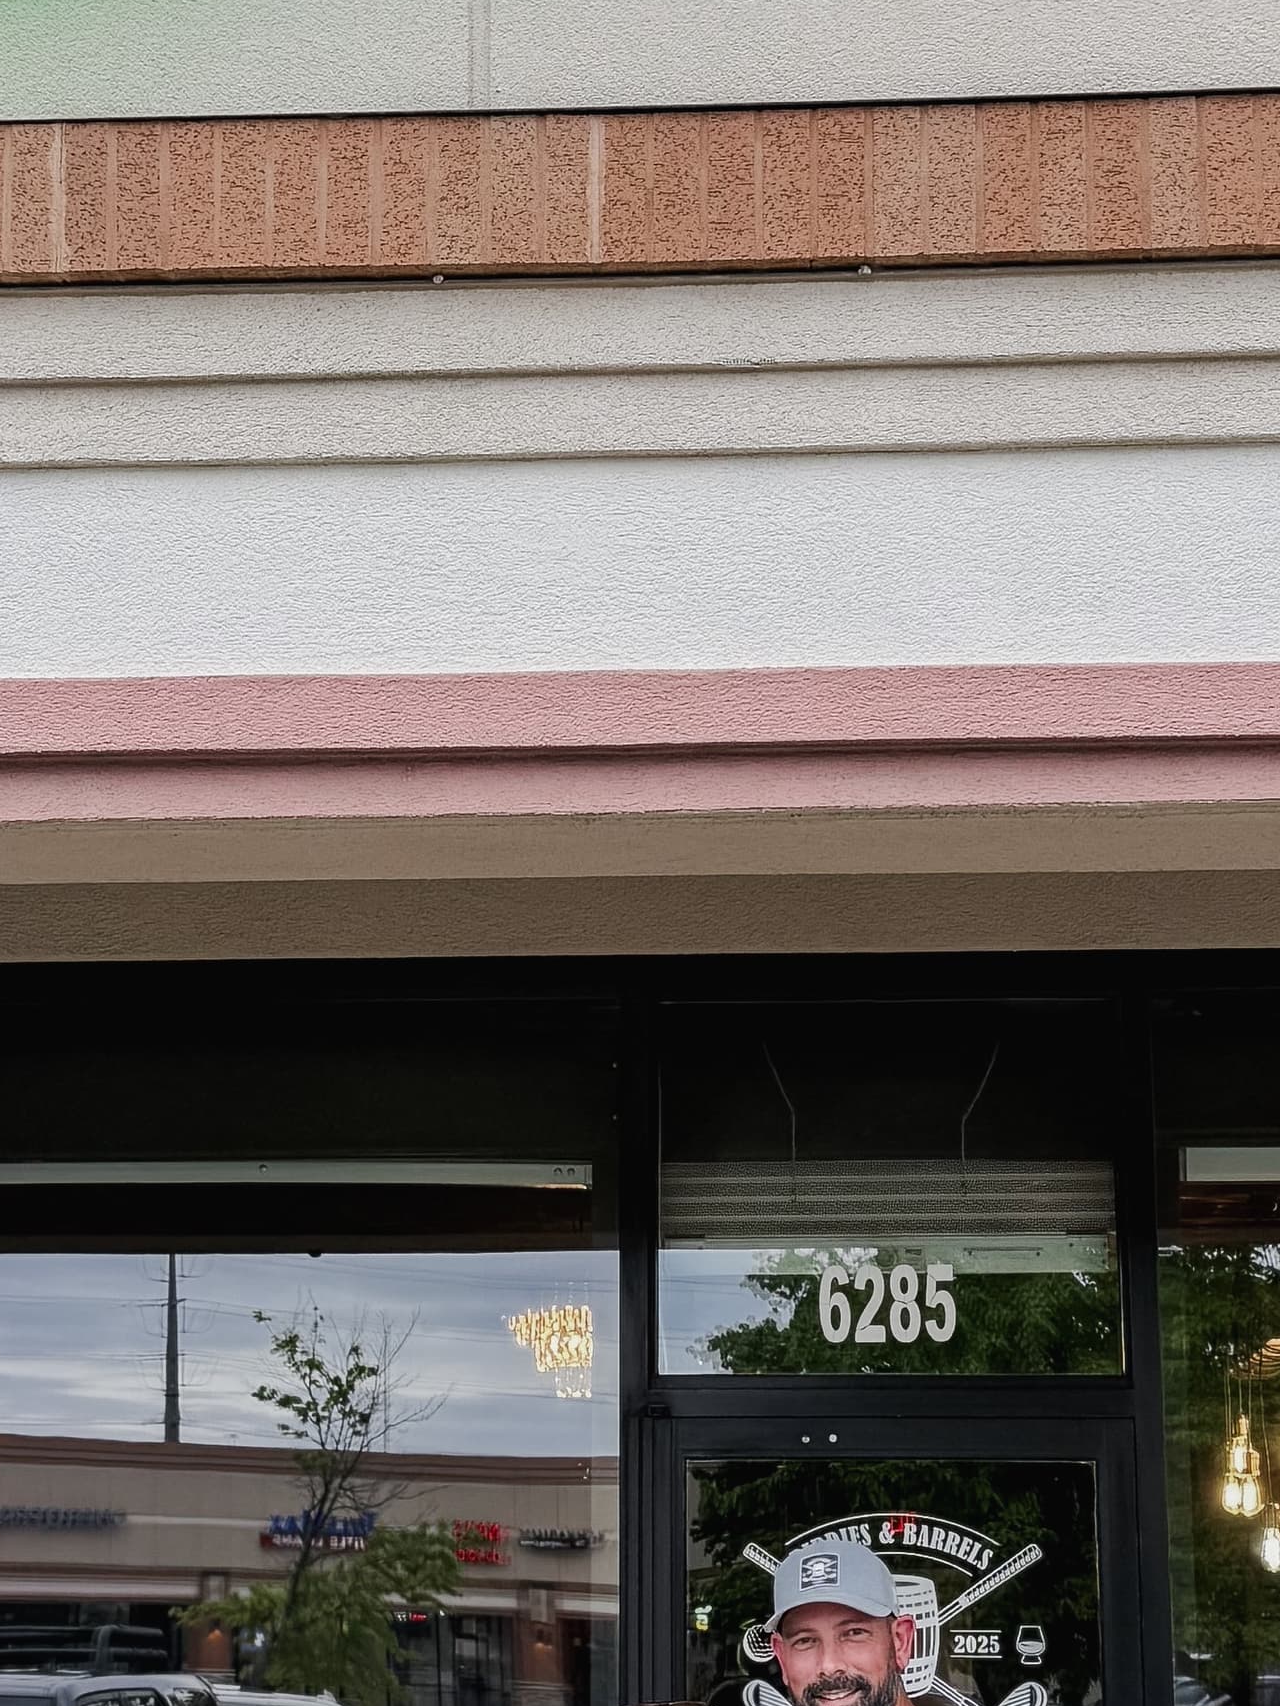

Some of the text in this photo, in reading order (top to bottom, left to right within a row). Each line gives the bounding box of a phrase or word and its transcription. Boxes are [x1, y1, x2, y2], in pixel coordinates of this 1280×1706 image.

[818, 1263, 958, 1344] 6285
[878, 1521, 896, 1545] &
[902, 1522, 994, 1571] BARRELS
[953, 1634, 1000, 1654] 2025
